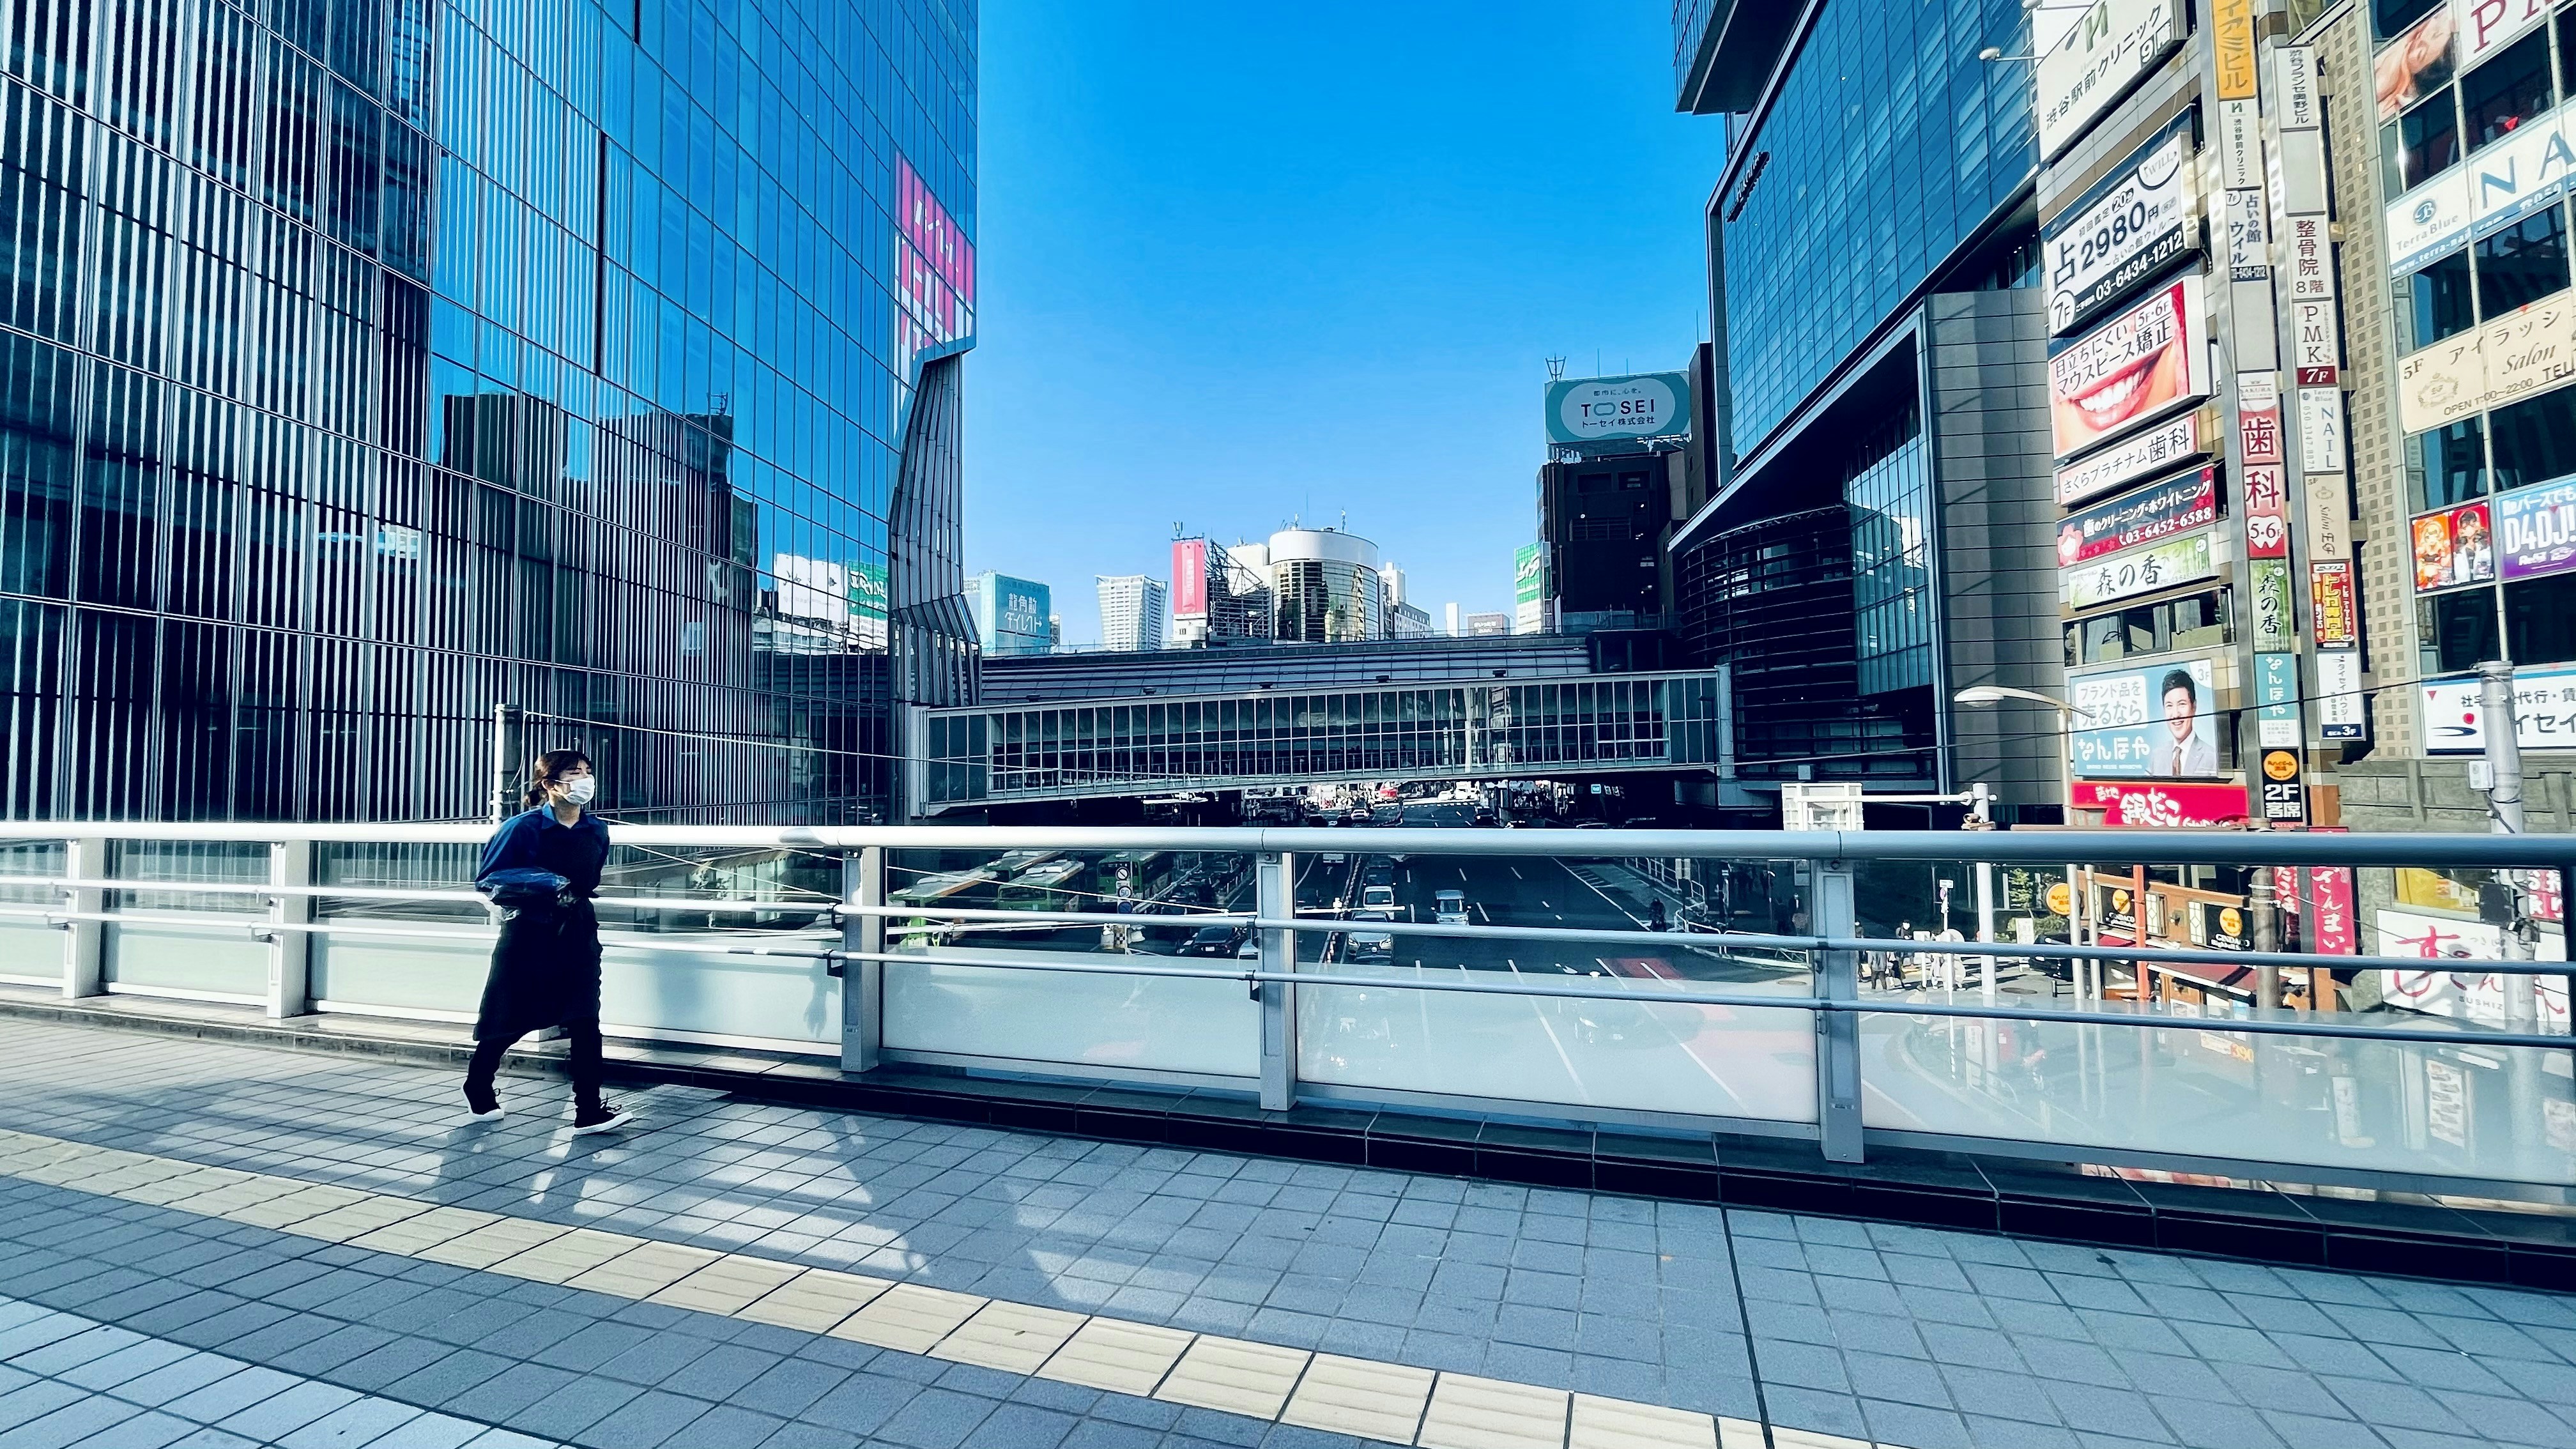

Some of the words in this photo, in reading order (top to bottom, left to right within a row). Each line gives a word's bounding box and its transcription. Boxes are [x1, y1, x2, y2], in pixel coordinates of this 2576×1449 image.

[2046, 4, 2161, 130] 渋谷駅前クリニック
[2245, 194, 2262, 242] 占いの館
[2096, 231, 2182, 301] 03-6434-1212
[2296, 220, 2319, 276] 整骨院
[2056, 325, 2128, 378] 目立ちにくい
[2057, 316, 2173, 396] マウスピース矯正
[2404, 358, 2424, 379] 5F
[2502, 342, 2556, 375] Salon
[2306, 369, 2329, 383] 7F
[1581, 399, 1655, 417] TOSEI
[1581, 415, 1655, 429] トーセイ株式会社
[2321, 406, 2337, 468] NAIL
[2064, 424, 2189, 494] さくらプラチナム歯科
[2242, 418, 2280, 509] 歯科
[2126, 507, 2212, 545] 03-6452-6588
[2097, 555, 2163, 597] 森の香
[2258, 574, 2281, 635] 森の香
[2080, 680, 2142, 700] ブランド品を
[2198, 668, 2210, 682] 3F
[2082, 700, 2142, 727] 売るなら
[2342, 726, 2356, 736] 3F
[2265, 784, 2299, 801] 2F
[2266, 802, 2301, 818] 客席
